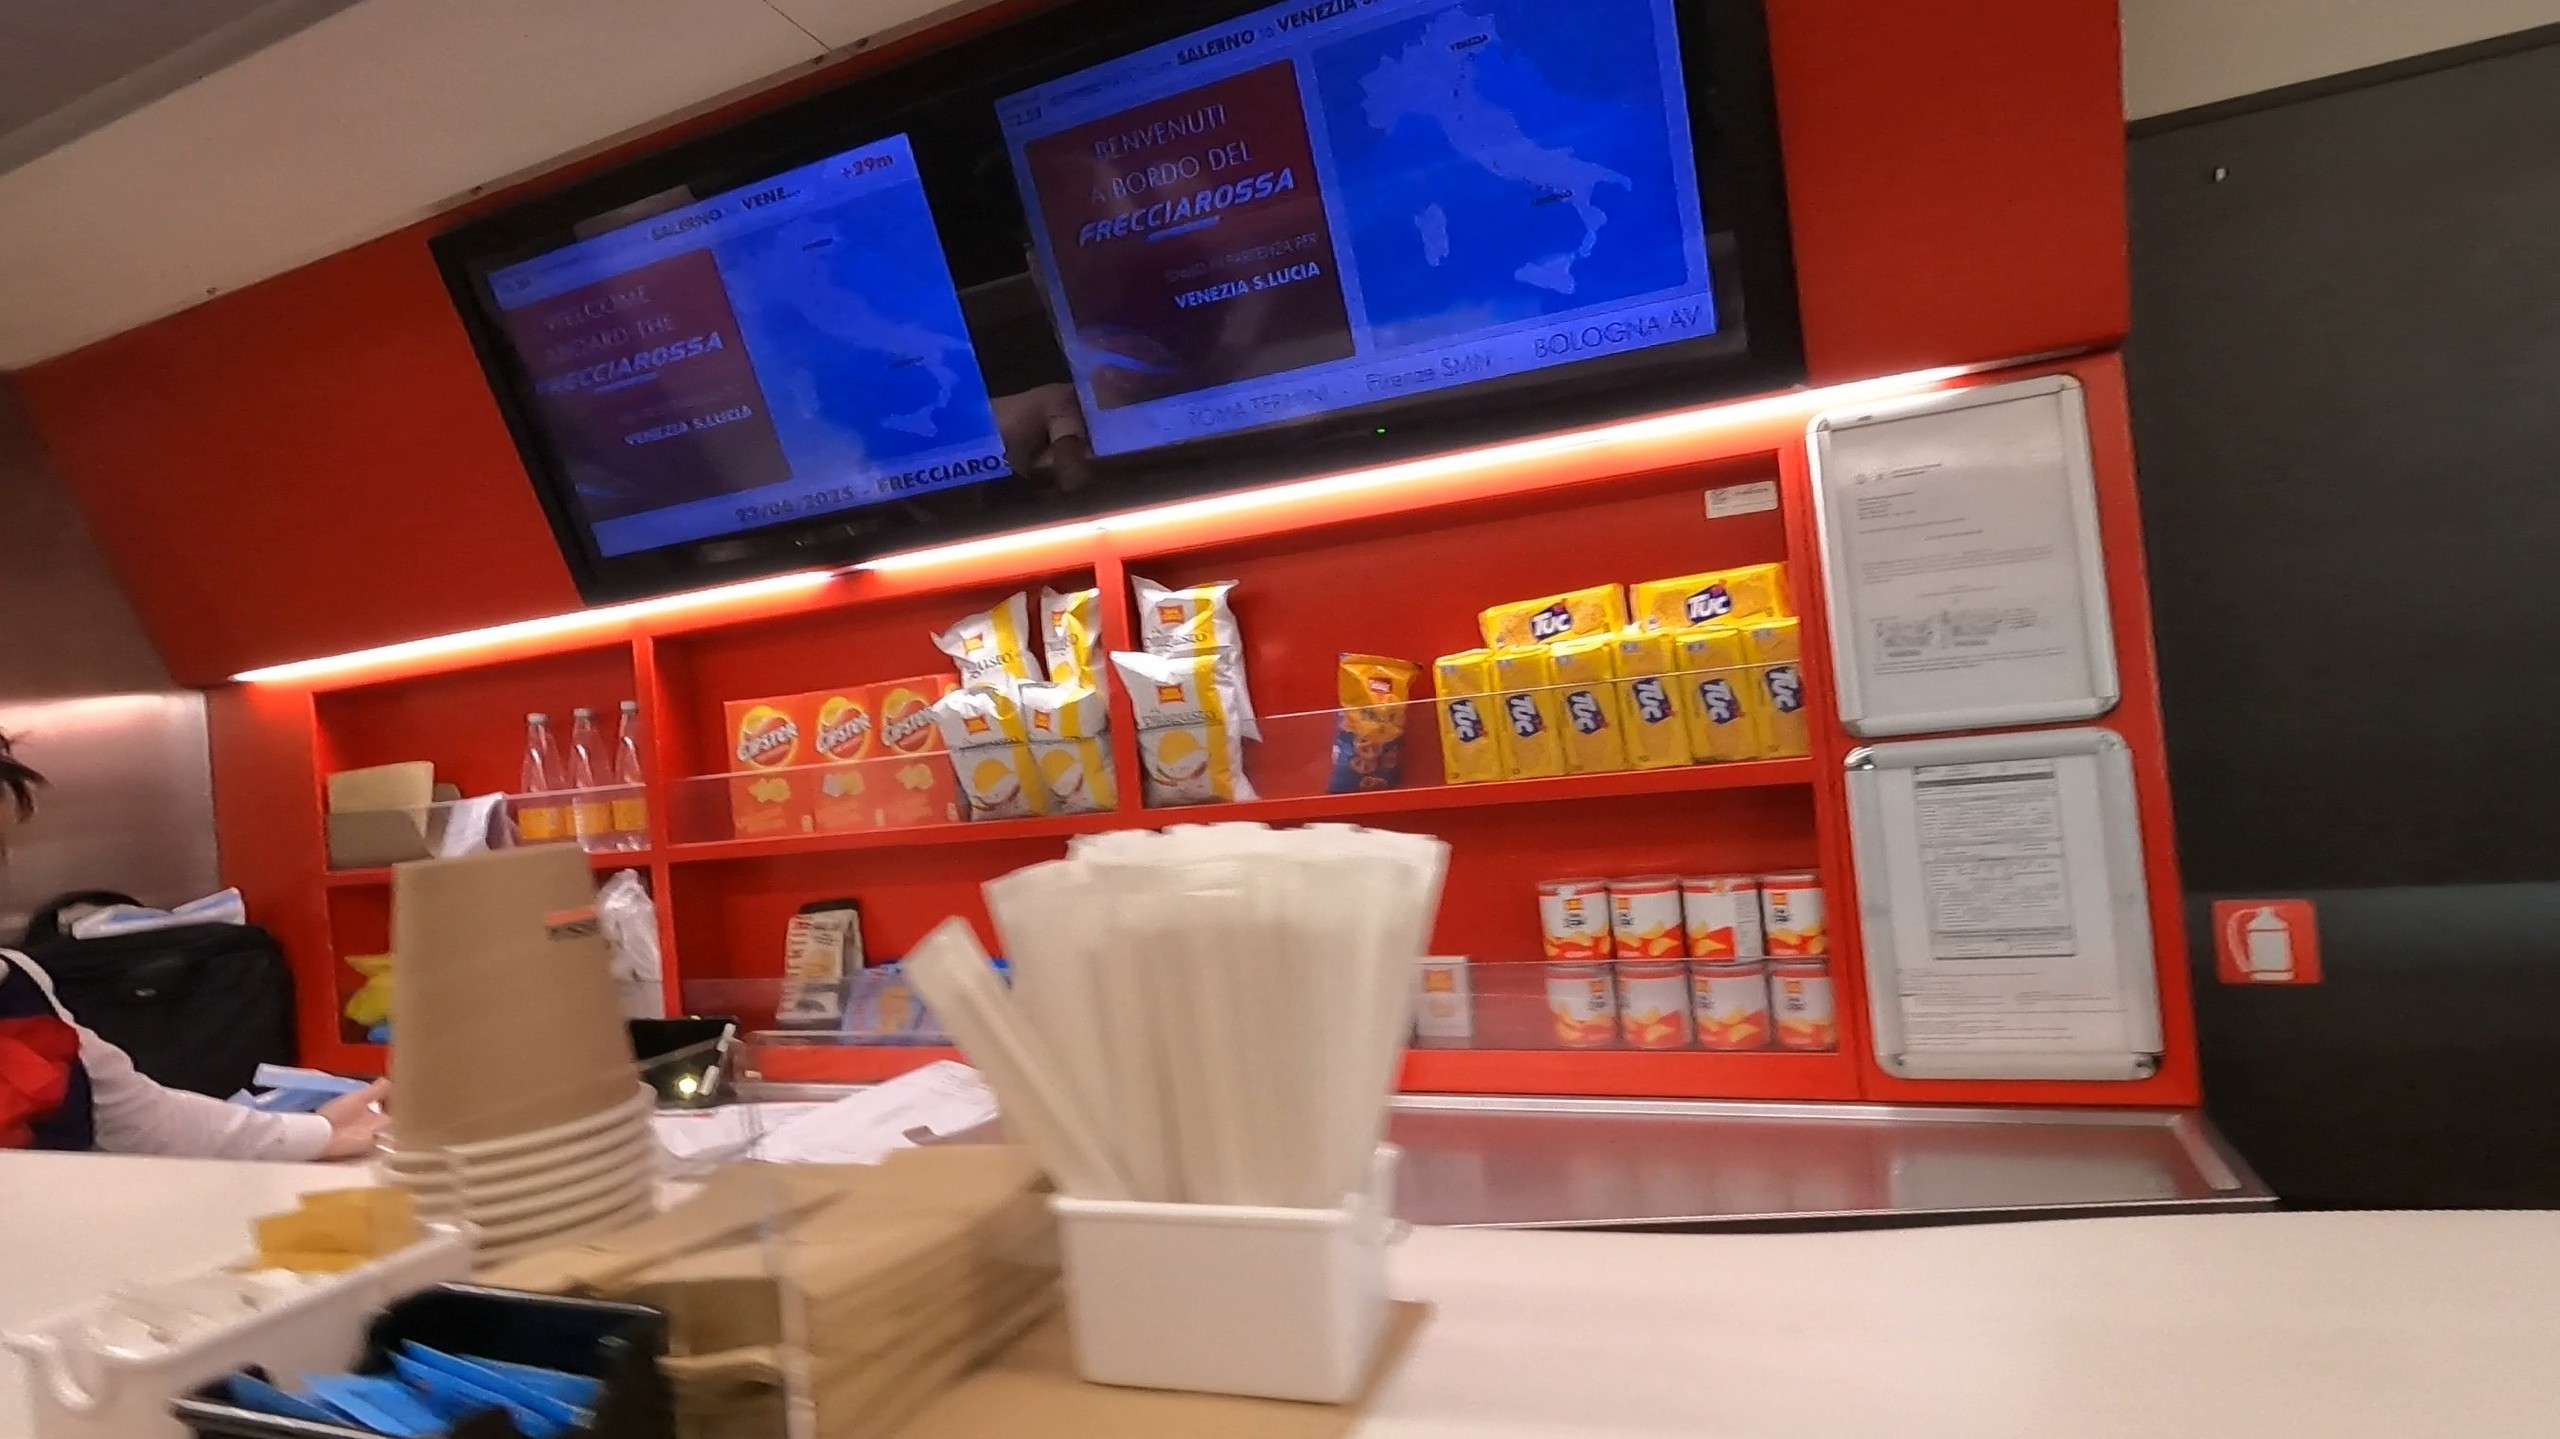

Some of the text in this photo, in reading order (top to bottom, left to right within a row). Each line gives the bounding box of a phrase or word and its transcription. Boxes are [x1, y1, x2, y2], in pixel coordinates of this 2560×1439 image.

[1177, 28, 1255, 65] SALERNO
[1276, 0, 1358, 32] VENEZIA
[1094, 102, 1227, 160] BENVENUTI
[1112, 155, 1200, 198] BORDO
[1207, 139, 1253, 172] DEL
[1078, 166, 1295, 248] FRECCIAROSSA
[1173, 278, 1250, 309] VENEZIA
[1252, 260, 1322, 291] S.LUCIA
[1533, 316, 1662, 359] BOLOGNA
[1669, 304, 1700, 329] AV
